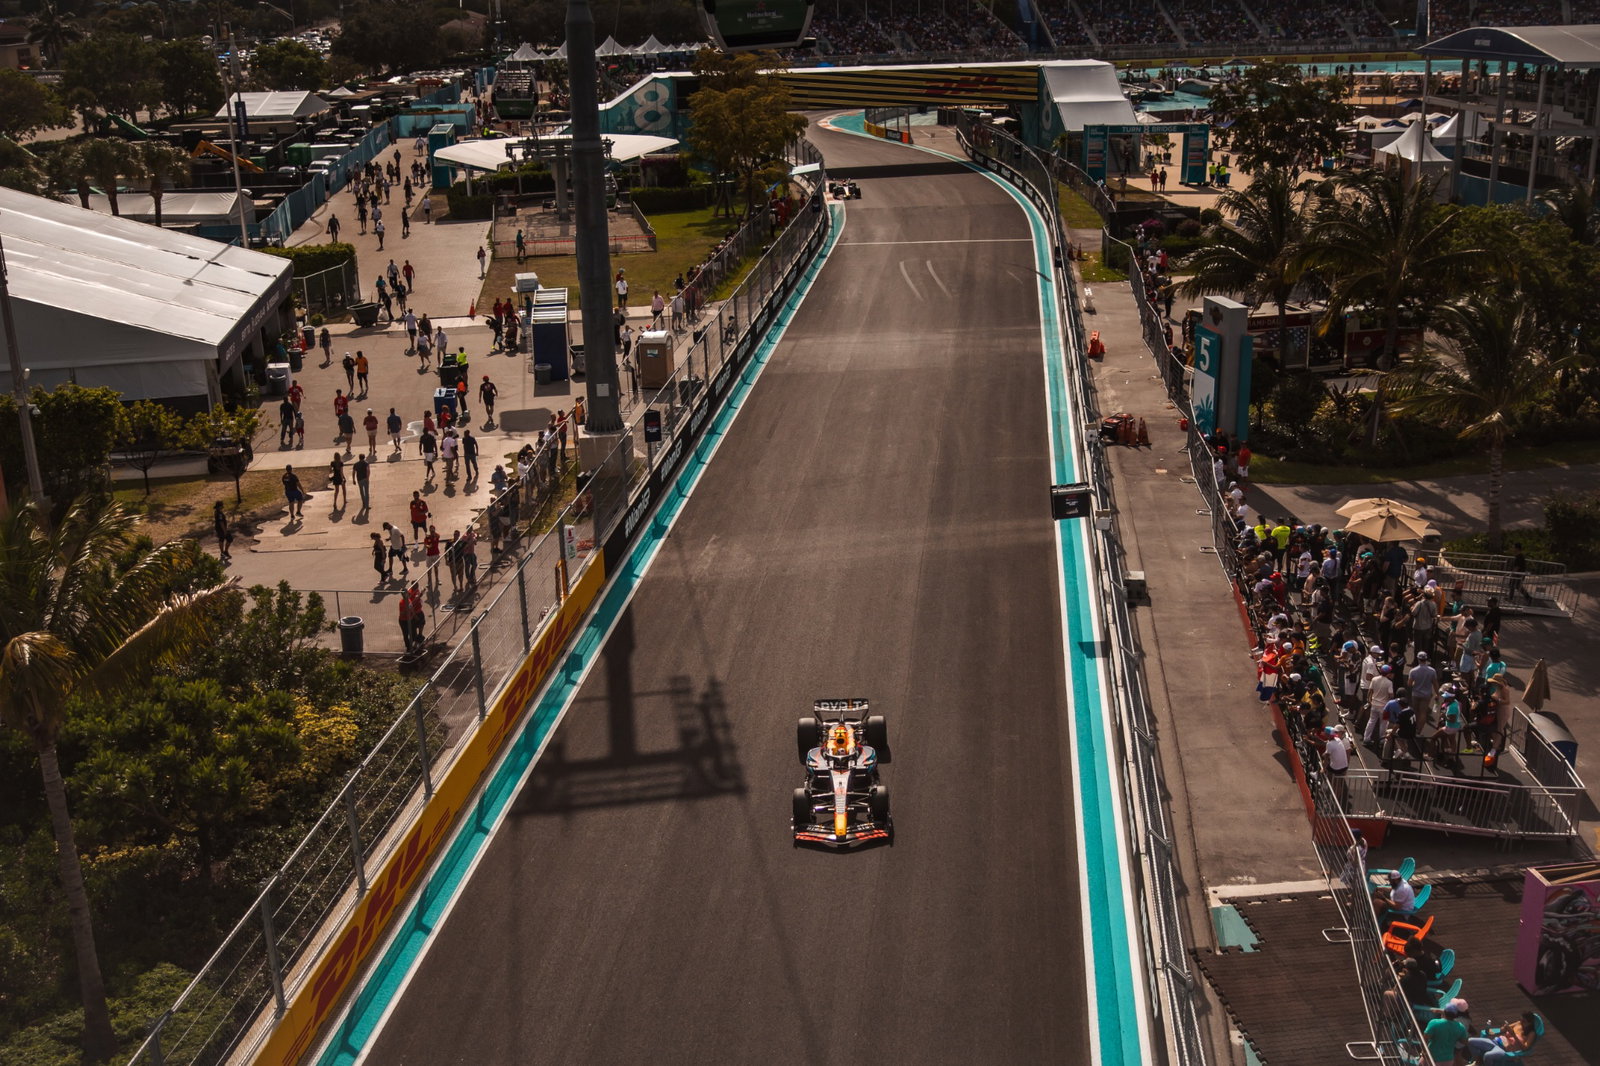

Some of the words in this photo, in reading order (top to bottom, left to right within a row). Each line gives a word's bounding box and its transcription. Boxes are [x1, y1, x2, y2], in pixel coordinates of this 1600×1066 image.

[634, 82, 672, 131] 8
[1143, 125, 1150, 133] 8
[1200, 337, 1210, 371] 5
[661, 438, 683, 482] #MiamiGP
[625, 487, 650, 539] #MiamiGP
[502, 611, 569, 733] DHL
[311, 823, 431, 1029] DHL
